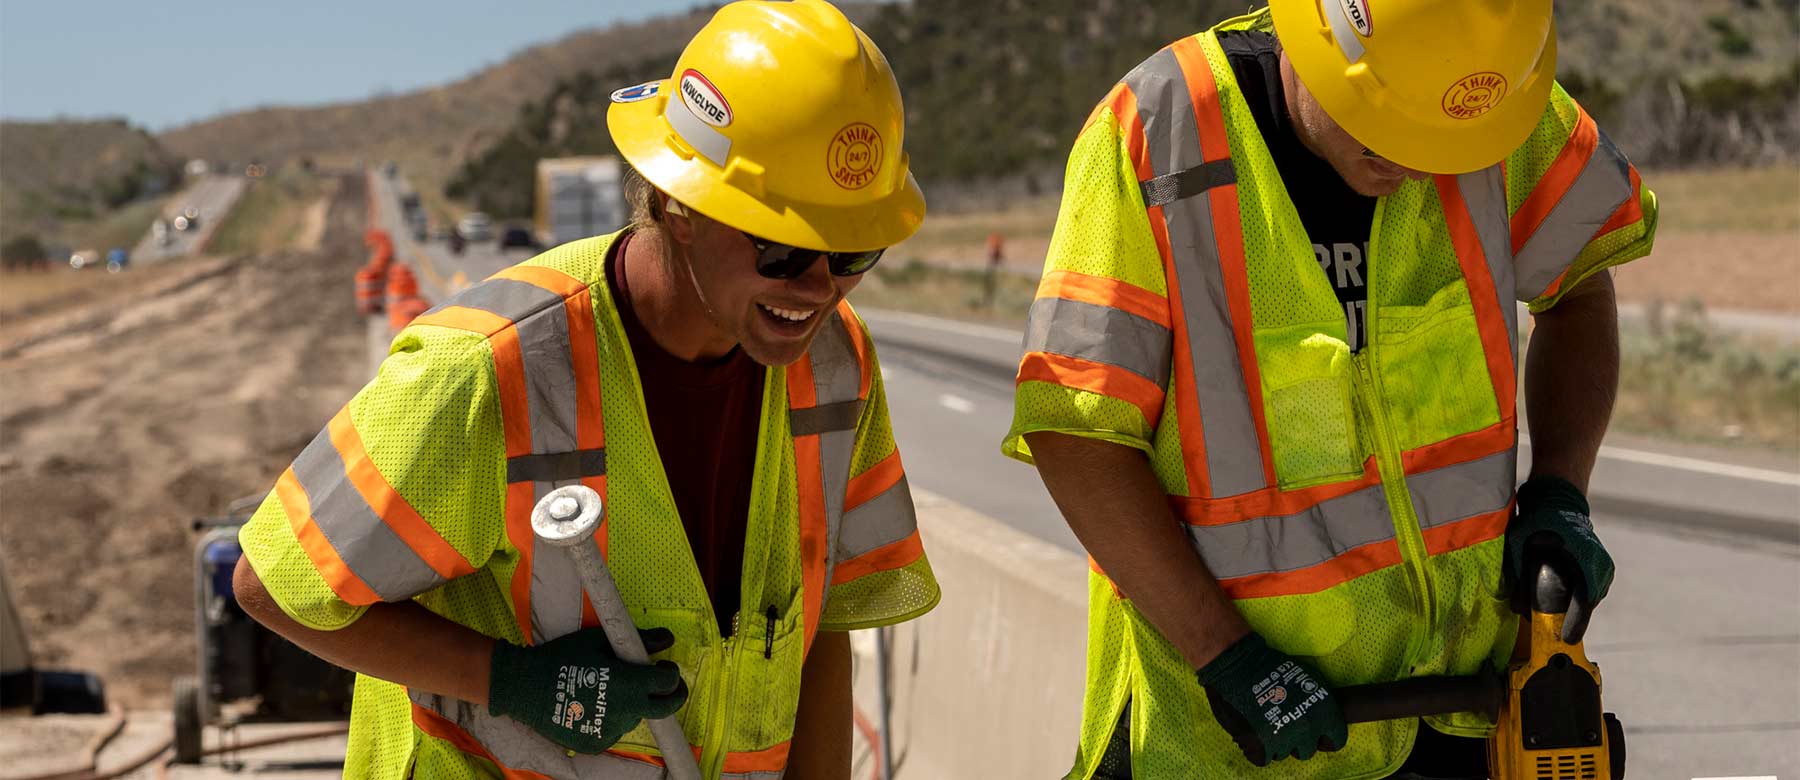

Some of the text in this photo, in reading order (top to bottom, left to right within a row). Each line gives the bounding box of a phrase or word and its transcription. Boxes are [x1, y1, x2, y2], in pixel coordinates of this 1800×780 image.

[1459, 76, 1502, 90] THINK
[1448, 103, 1490, 117] SAFETY
[839, 127, 876, 146] THINK
[835, 165, 874, 186] SAFETY
